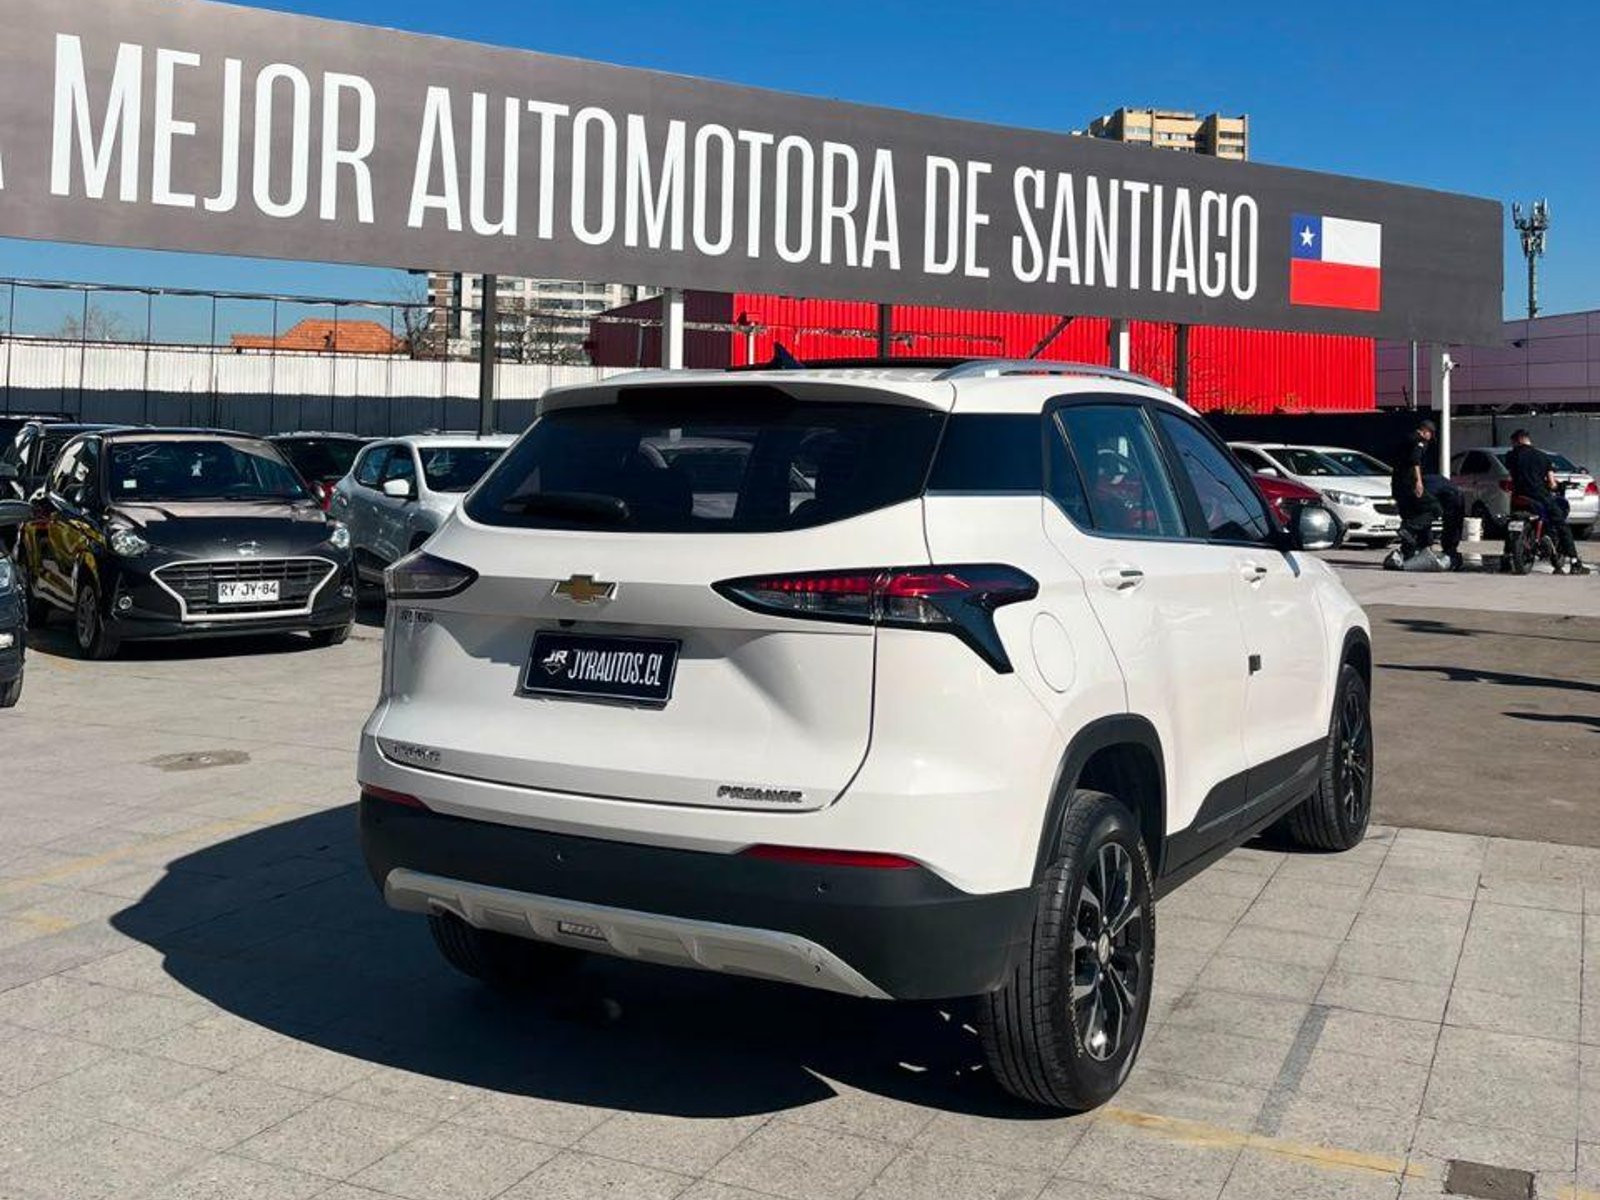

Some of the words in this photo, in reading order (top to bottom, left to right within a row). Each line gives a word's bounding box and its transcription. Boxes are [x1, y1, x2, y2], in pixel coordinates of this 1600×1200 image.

[50, 32, 377, 224] MEJOR
[407, 86, 901, 271] AUTOMOTORA
[923, 155, 992, 279] DE
[1011, 166, 1259, 301] SANTIAGO
[567, 650, 663, 686] JYRAUTOS.CL
[716, 785, 803, 804] PREMIER
